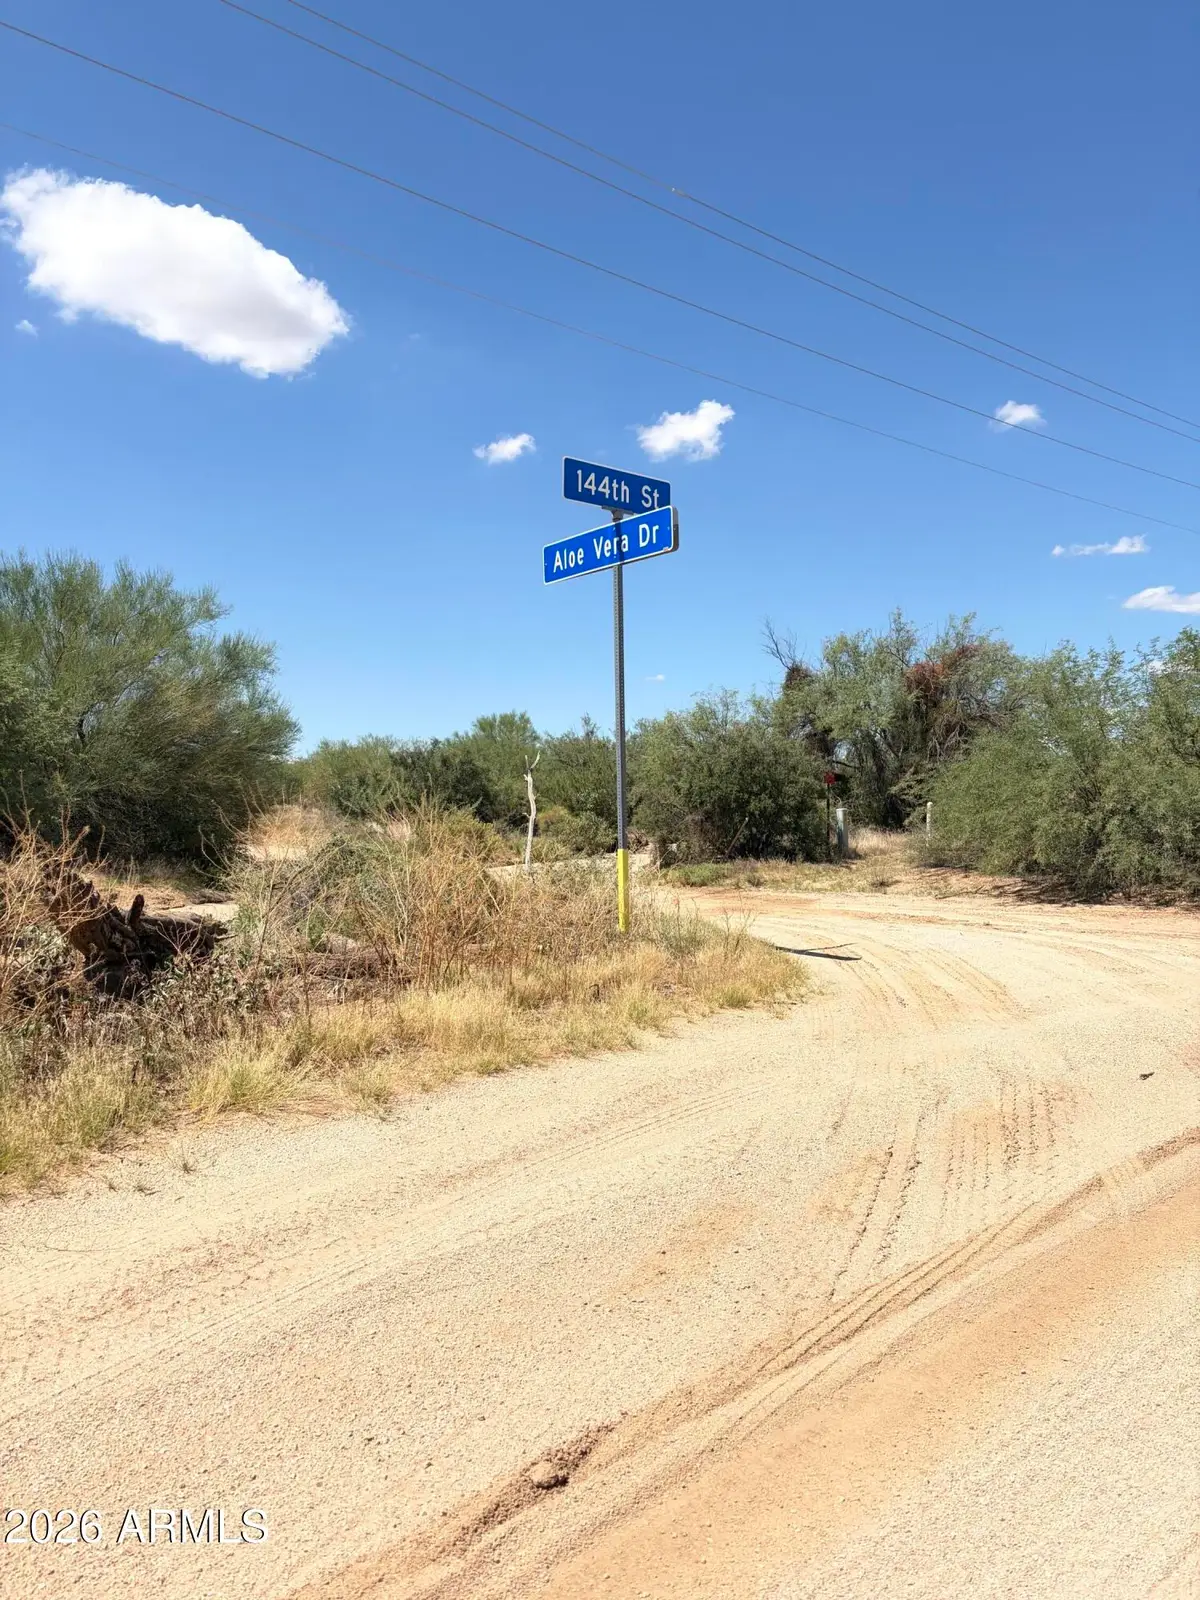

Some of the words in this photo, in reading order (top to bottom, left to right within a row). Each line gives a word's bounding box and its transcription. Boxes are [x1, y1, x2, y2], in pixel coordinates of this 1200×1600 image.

[577, 470, 630, 503] 144th
[641, 485, 659, 509] St
[553, 548, 584, 573] Aloe
[593, 534, 629, 559] Vera
[639, 523, 659, 547] Dr
